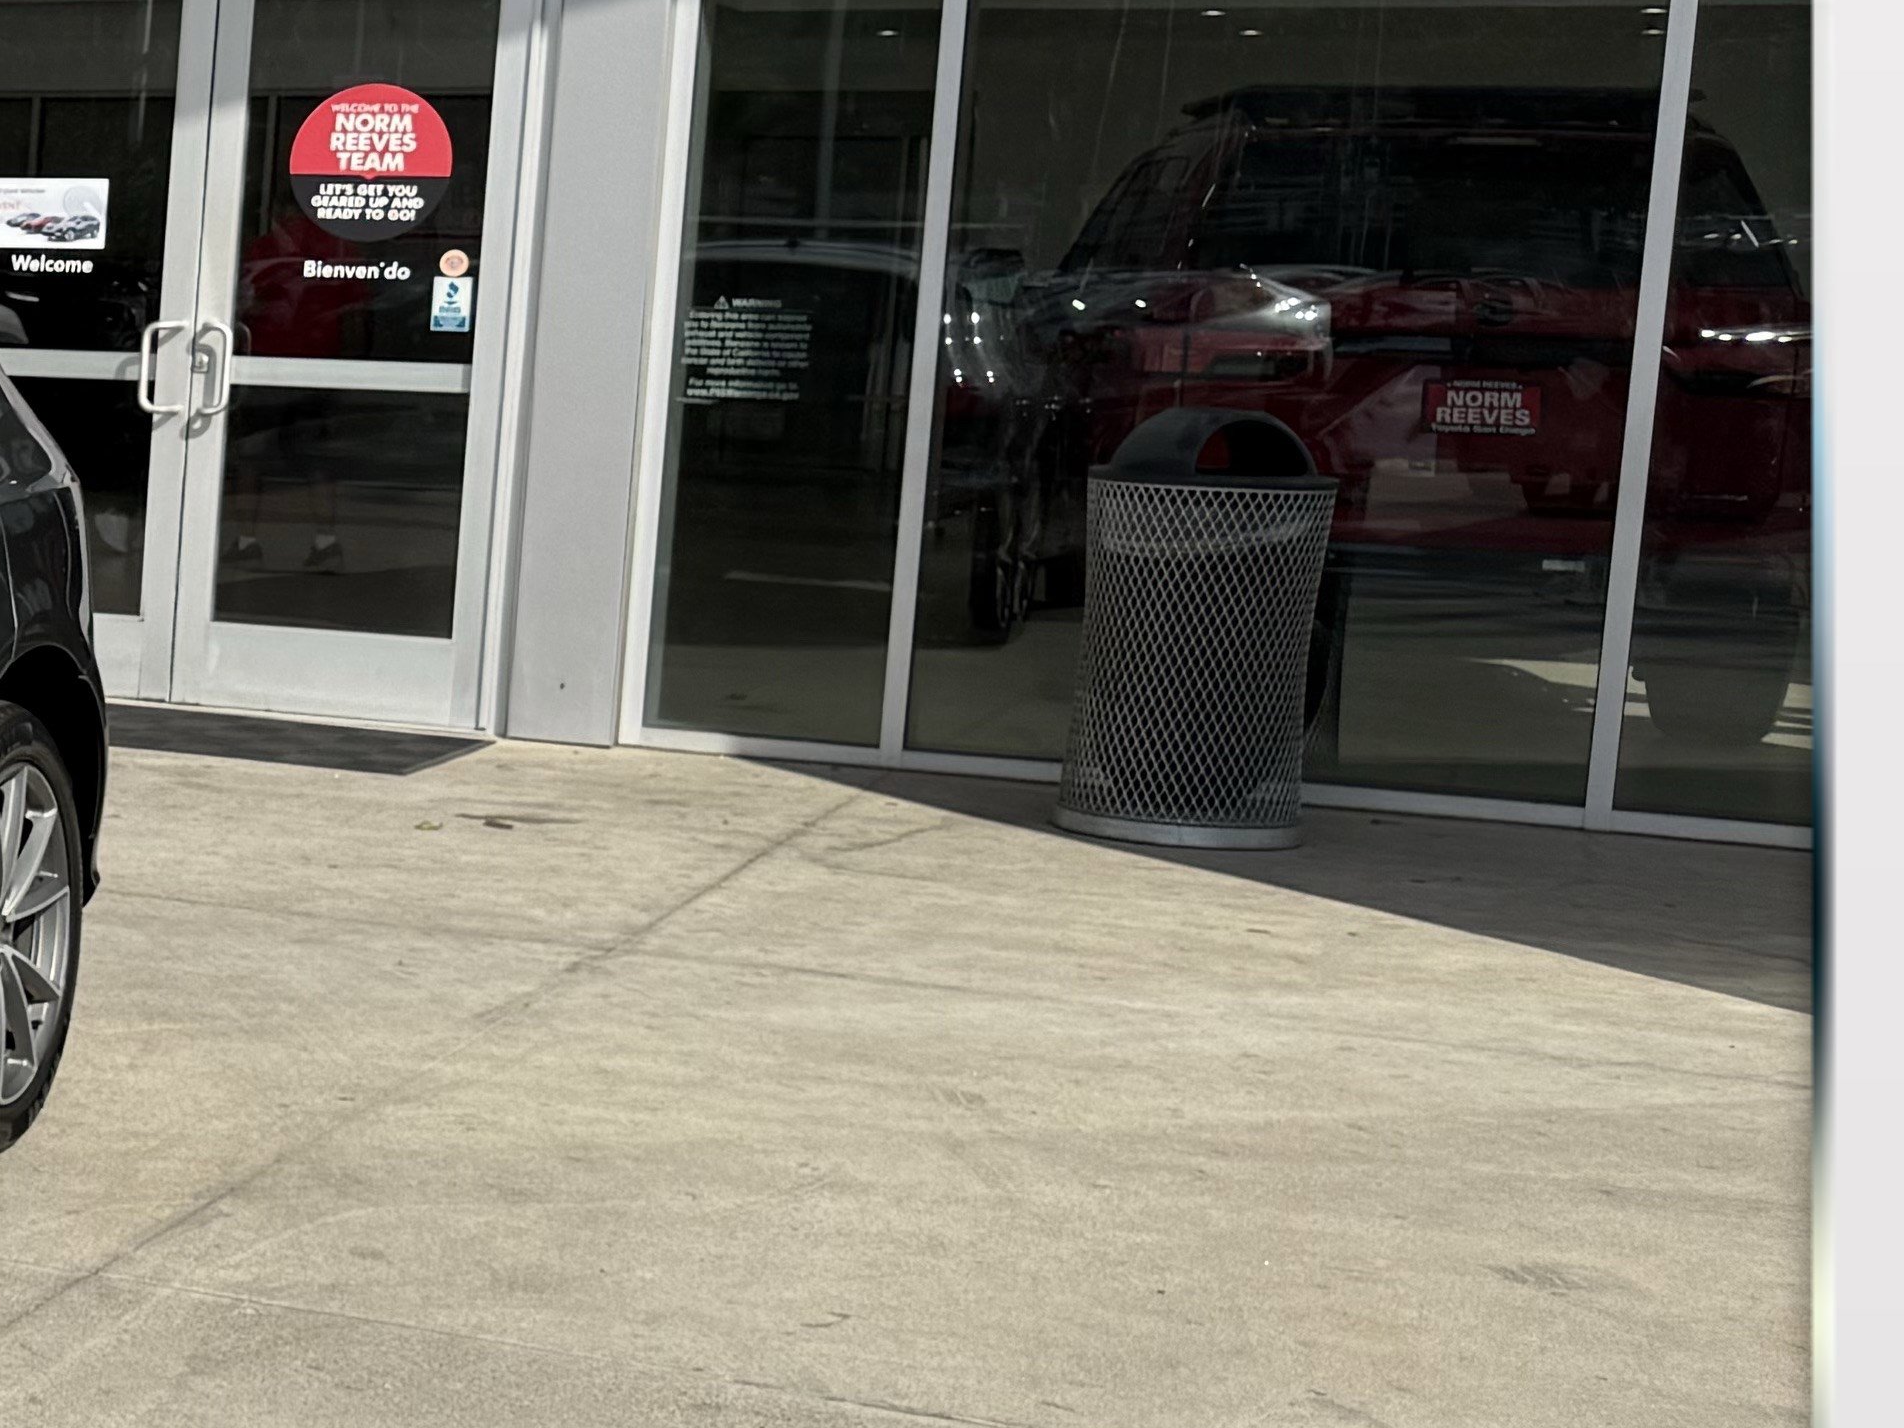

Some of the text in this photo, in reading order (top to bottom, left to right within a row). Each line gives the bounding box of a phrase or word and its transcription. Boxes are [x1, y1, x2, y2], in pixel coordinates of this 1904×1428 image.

[384, 104, 398, 113] TO
[335, 113, 413, 133] NORM
[330, 132, 417, 152] REEVES
[336, 152, 404, 172] TEAM
[319, 183, 418, 197] LET'S GET YOU
[311, 195, 424, 210] GEARED UP AND
[317, 207, 416, 222] READY TO GO!
[11, 253, 94, 274] Welcome
[1446, 390, 1522, 408] NORM
[1436, 406, 1531, 426] REEVES
